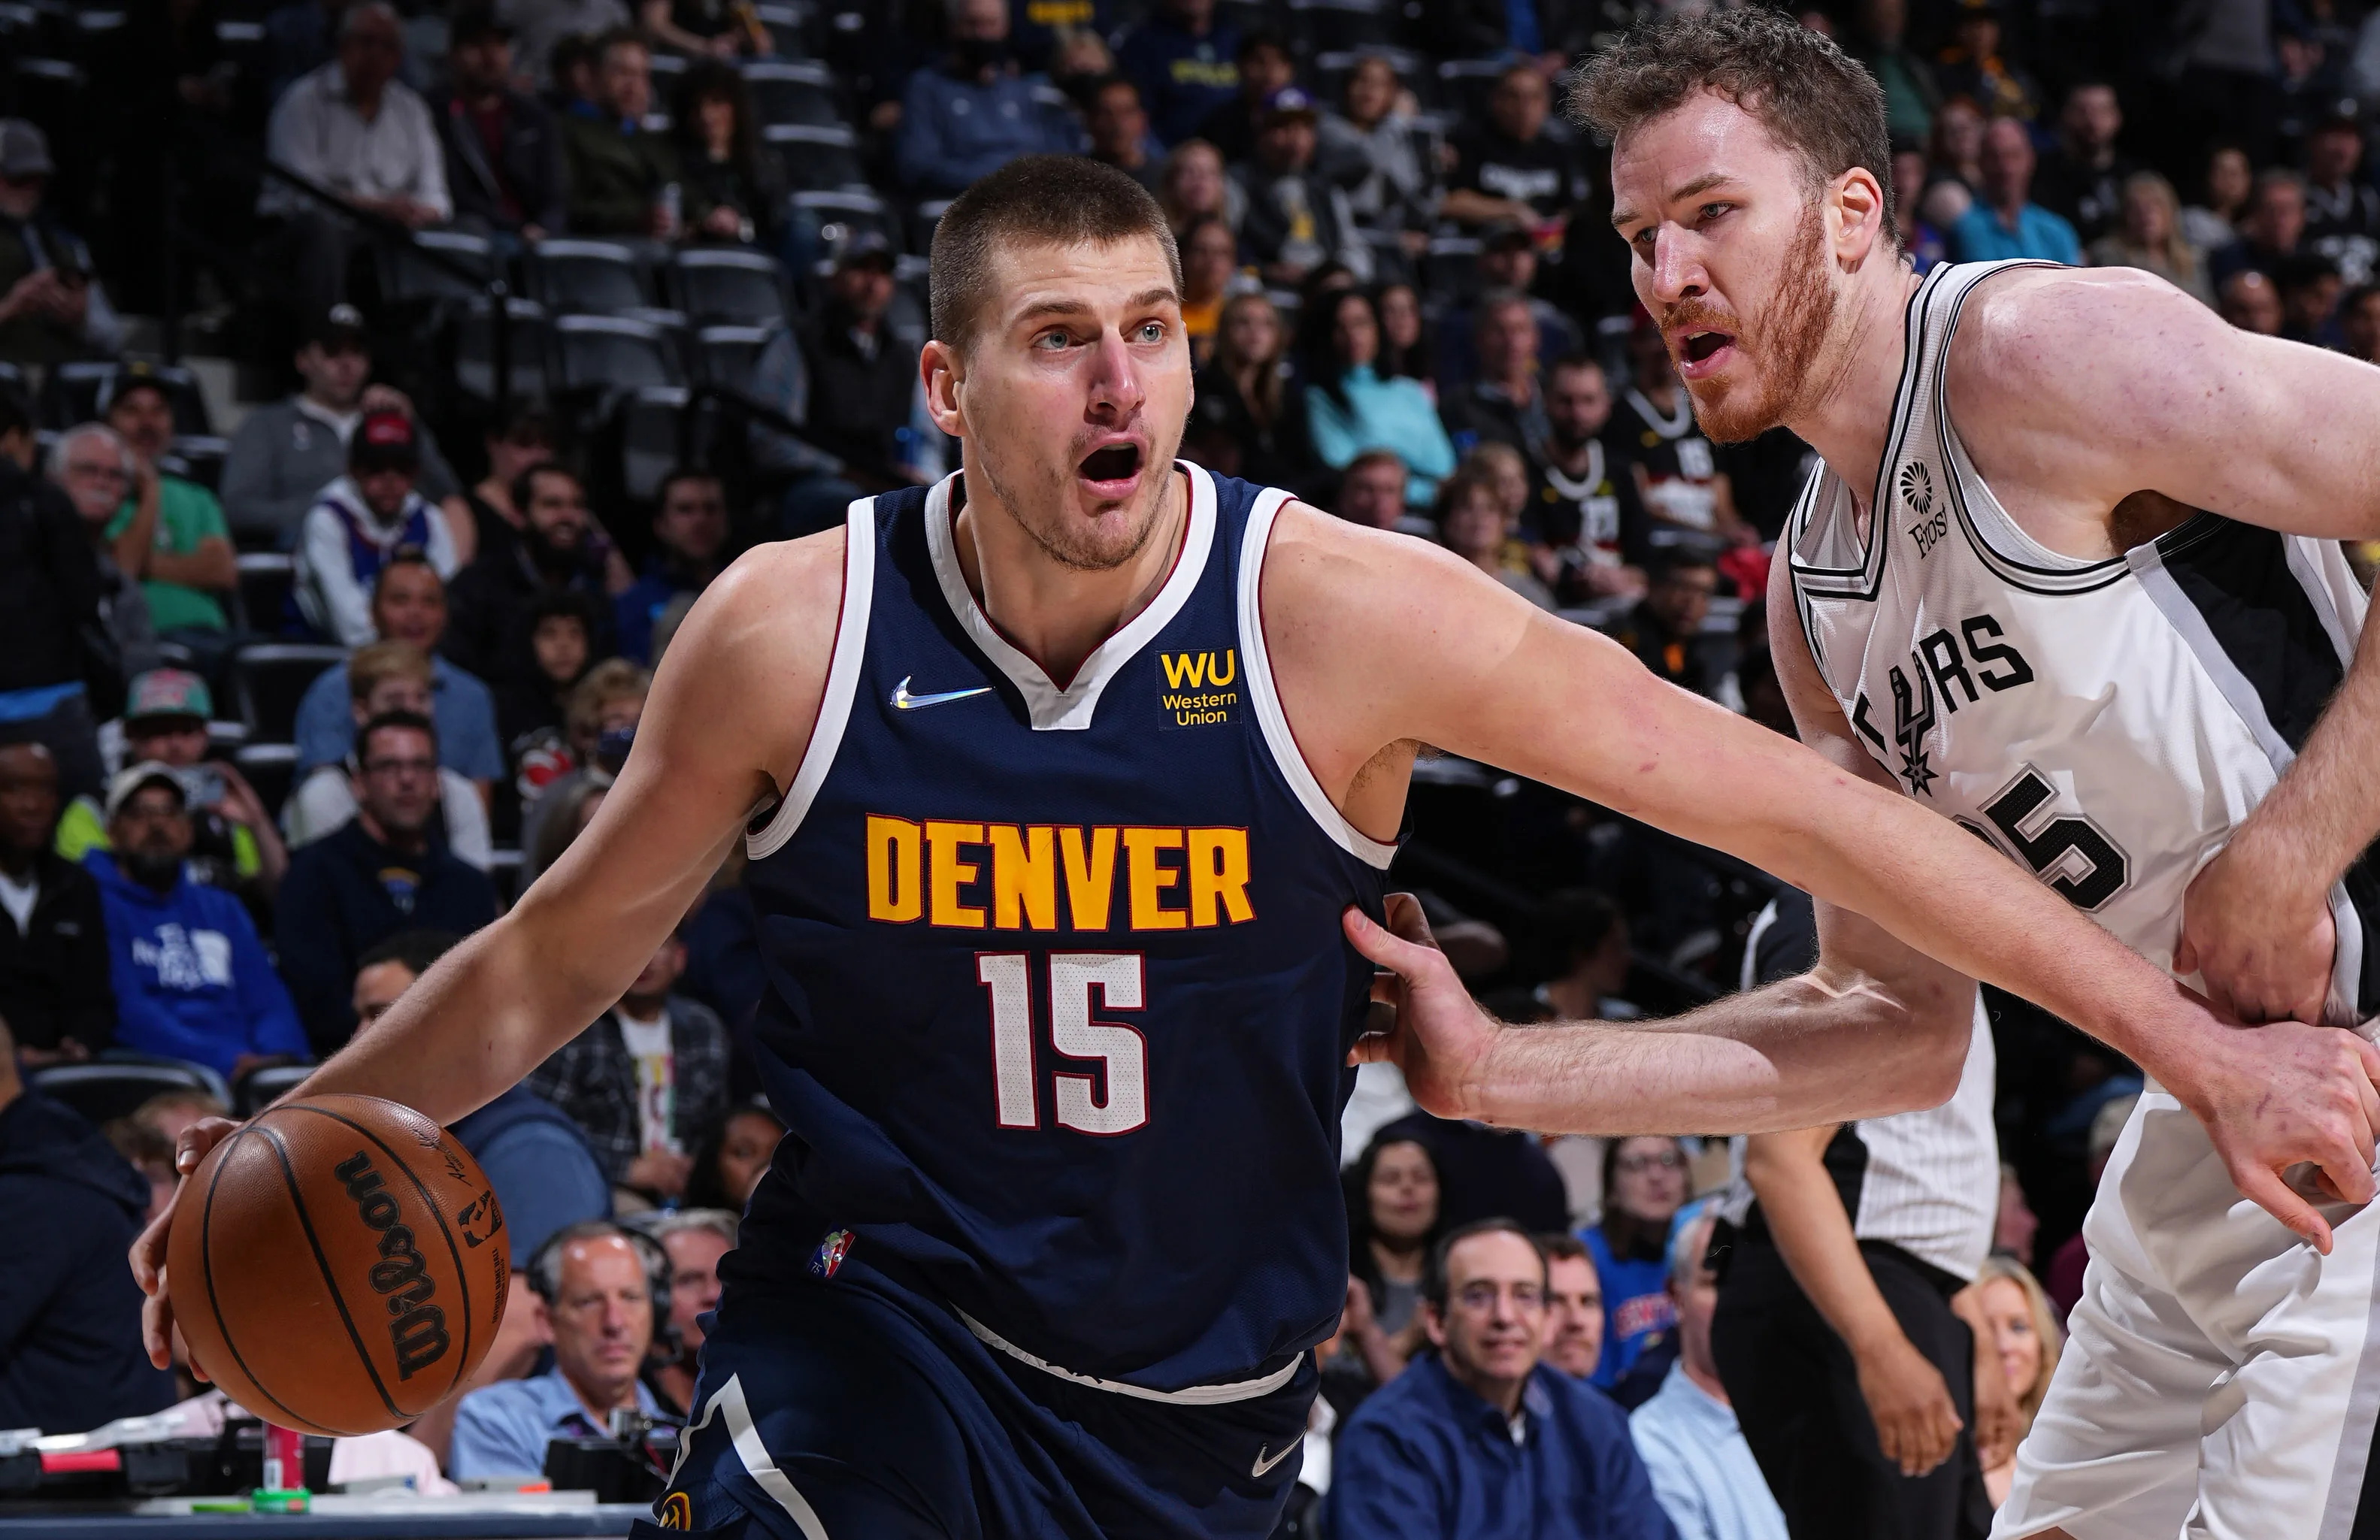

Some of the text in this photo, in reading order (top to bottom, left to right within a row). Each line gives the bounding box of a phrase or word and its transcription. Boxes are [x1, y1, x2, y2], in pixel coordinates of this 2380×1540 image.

[1161, 649, 1235, 689] WU
[1162, 693, 1237, 710] Western
[1176, 709, 1227, 726] Union
[865, 812, 1258, 933] DENVER
[1951, 762, 2132, 914] 5
[974, 949, 1151, 1138] 15
[335, 1150, 450, 1381] Wilson
